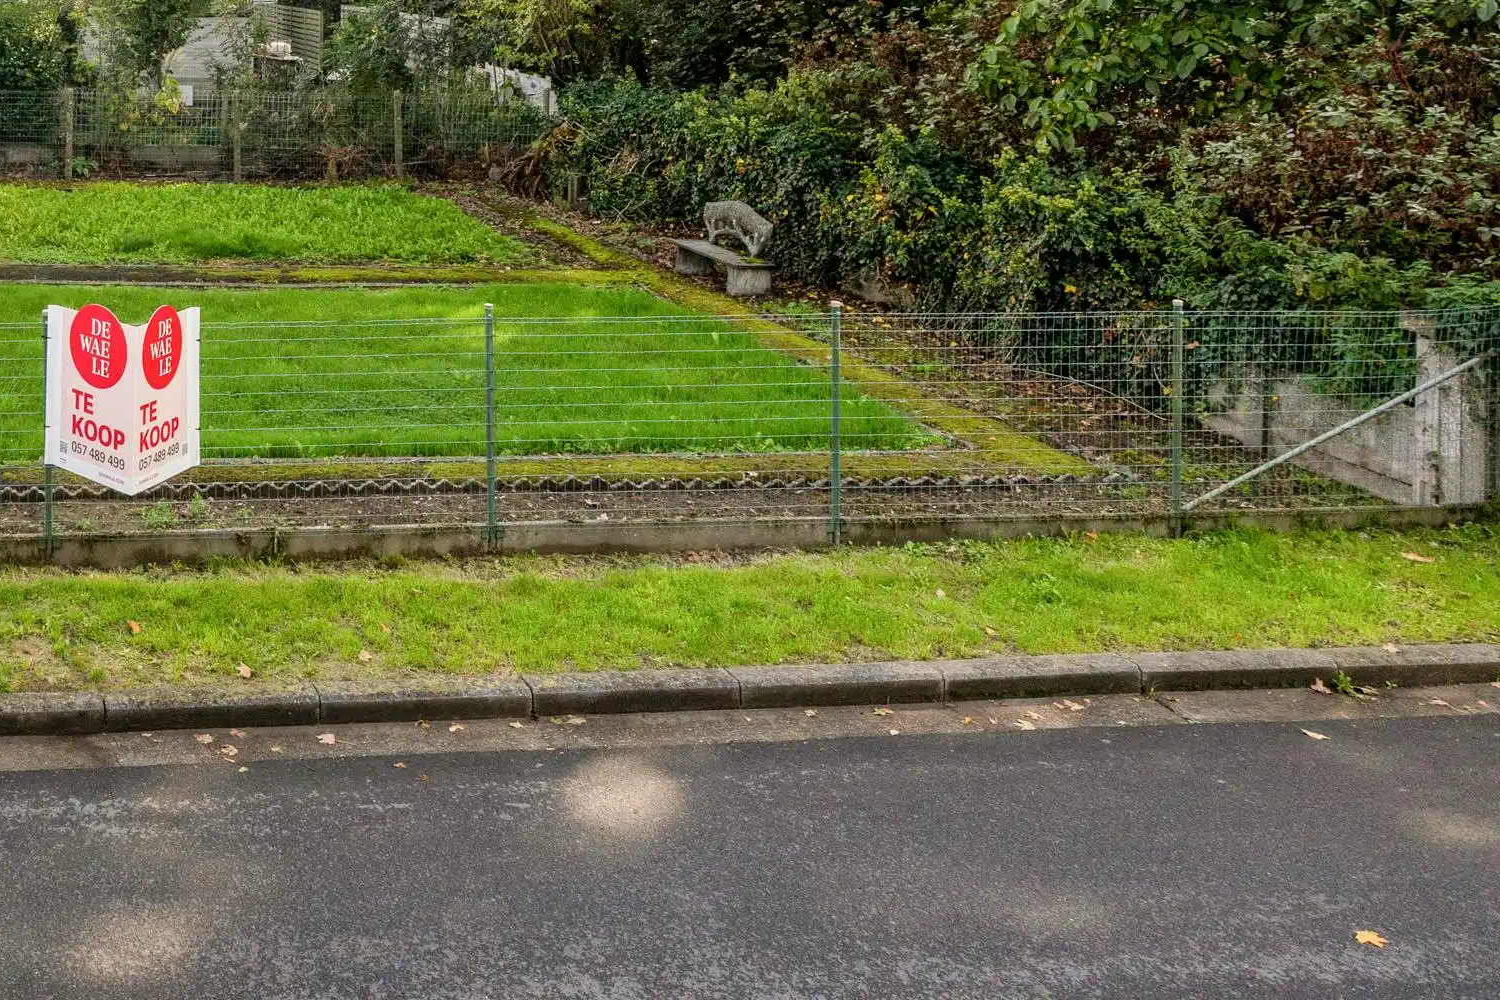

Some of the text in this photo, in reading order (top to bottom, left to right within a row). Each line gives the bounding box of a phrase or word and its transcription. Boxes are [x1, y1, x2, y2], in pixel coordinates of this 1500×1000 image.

[91, 318, 111, 338] DE
[159, 318, 172, 338] DE
[80, 334, 110, 358] WAE
[150, 338, 172, 360] WAE
[92, 357, 110, 378] LE
[159, 356, 172, 376] LE
[72, 388, 94, 415] TE
[140, 400, 157, 425] TE
[72, 415, 125, 450] KOOP
[139, 417, 179, 453] KOOP
[72, 441, 125, 470] 057 489 499
[139, 442, 179, 470] 057 489 499
